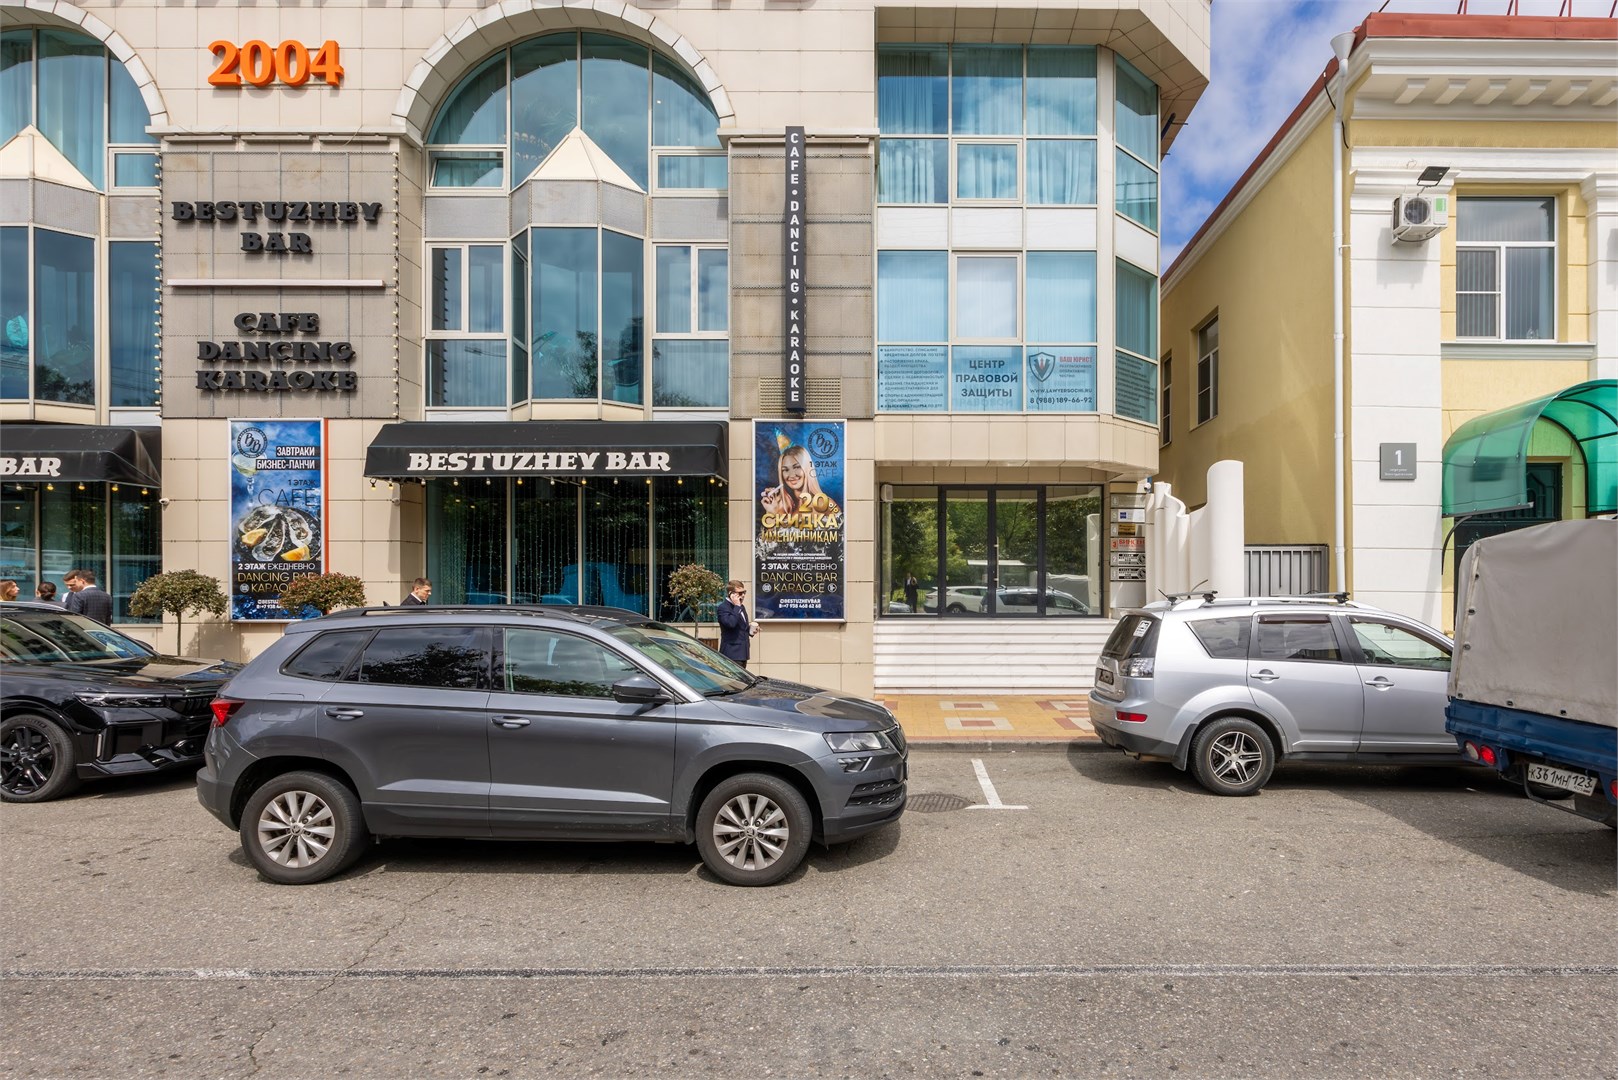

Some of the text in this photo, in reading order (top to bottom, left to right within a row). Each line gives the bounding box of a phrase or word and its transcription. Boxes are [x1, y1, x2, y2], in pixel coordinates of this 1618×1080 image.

[207, 39, 345, 88] 2004
[789, 132, 800, 185] CAFE
[240, 232, 313, 254] BAR
[789, 200, 800, 293] DANCING
[233, 312, 320, 332] CAFE
[196, 341, 356, 361] DANCING
[789, 309, 800, 402] KARAOKE
[969, 360, 1005, 370] ЦЕНТР
[195, 370, 358, 390] KARAOKE
[955, 372, 1018, 383] ПРАВОВОЙ
[961, 388, 1013, 398] ЗАЩИТЫ
[276, 446, 315, 456] ЗАВТРАКИ
[1395, 449, 1402, 466] 1
[0, 457, 62, 477] BAR
[256, 459, 315, 470] БИЗНЕС-ЛАНЧИ
[605, 452, 671, 472] BAR
[809, 469, 838, 478] CAFE
[257, 488, 316, 507] CAFE
[798, 493, 839, 514] 20%
[761, 513, 839, 531] СКИДКА
[761, 530, 838, 543] ИМЕНИННИКАМ
[267, 563, 316, 571] ЕЖЕДНЕВНО
[791, 563, 838, 571] ЕЖЕДНЕВНО
[237, 572, 290, 582] DANCING
[761, 572, 838, 582] DANCING BAR
[773, 583, 825, 593] KARAOKE
[1572, 774, 1593, 789] 123
